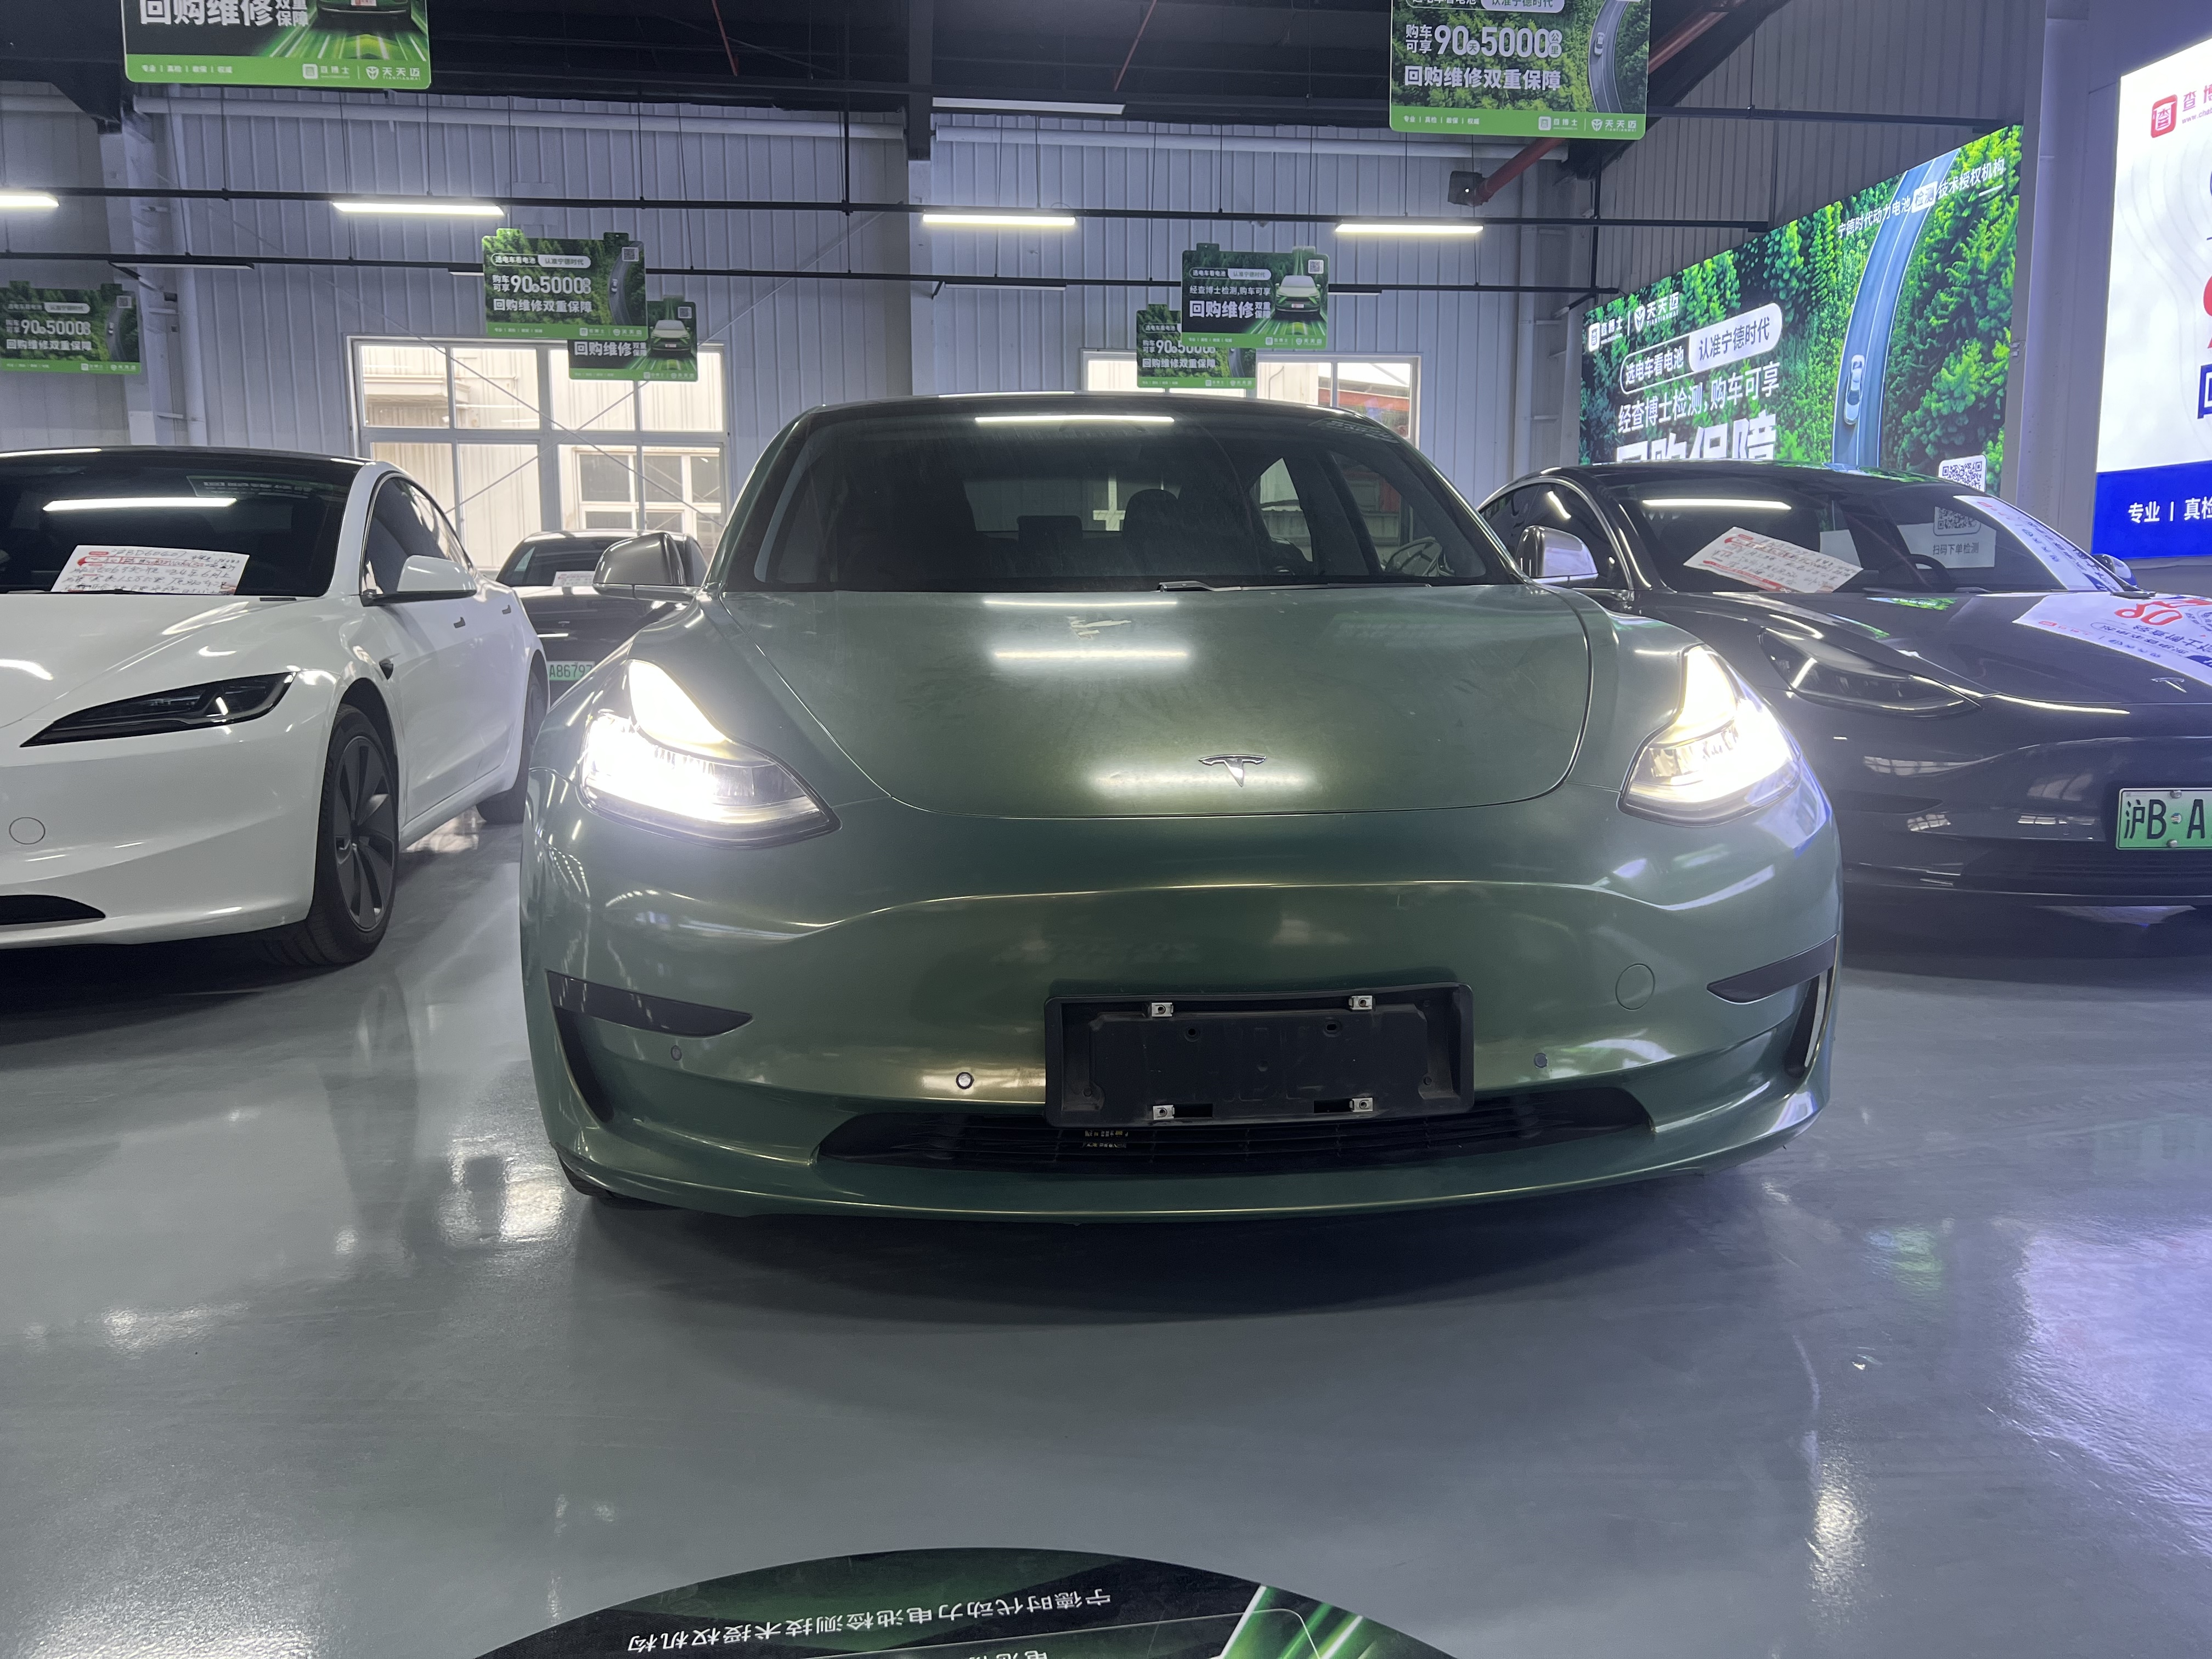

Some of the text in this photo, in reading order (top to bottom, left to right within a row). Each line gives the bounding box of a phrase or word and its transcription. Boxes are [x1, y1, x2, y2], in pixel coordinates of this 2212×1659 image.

[140, 0, 273, 26] 回购维修
[1406, 24, 1432, 38] 购车
[1406, 40, 1432, 54] 可享
[382, 66, 420, 77] 天天迈
[1405, 65, 1561, 91] 回购维修双重保障
[1605, 119, 1637, 128] 天天迈
[1838, 157, 2006, 239] 宁德时代动力电池检测技术授权机构
[493, 298, 592, 313] 回购维修双重保障
[1189, 300, 1254, 319] 回购维修
[1646, 291, 1679, 320] 天天迈
[574, 341, 632, 357] 回购维修
[1626, 317, 1770, 385] 选电车看电池 认准宁德时代
[1618, 361, 1781, 433] 经查博士检测,购车可享
[2128, 501, 2160, 523] 专业
[1932, 542, 1980, 556] 扫码下单检测
[627, 1588, 1111, 1653] 宁德时代动力电池检测技术授权机构
